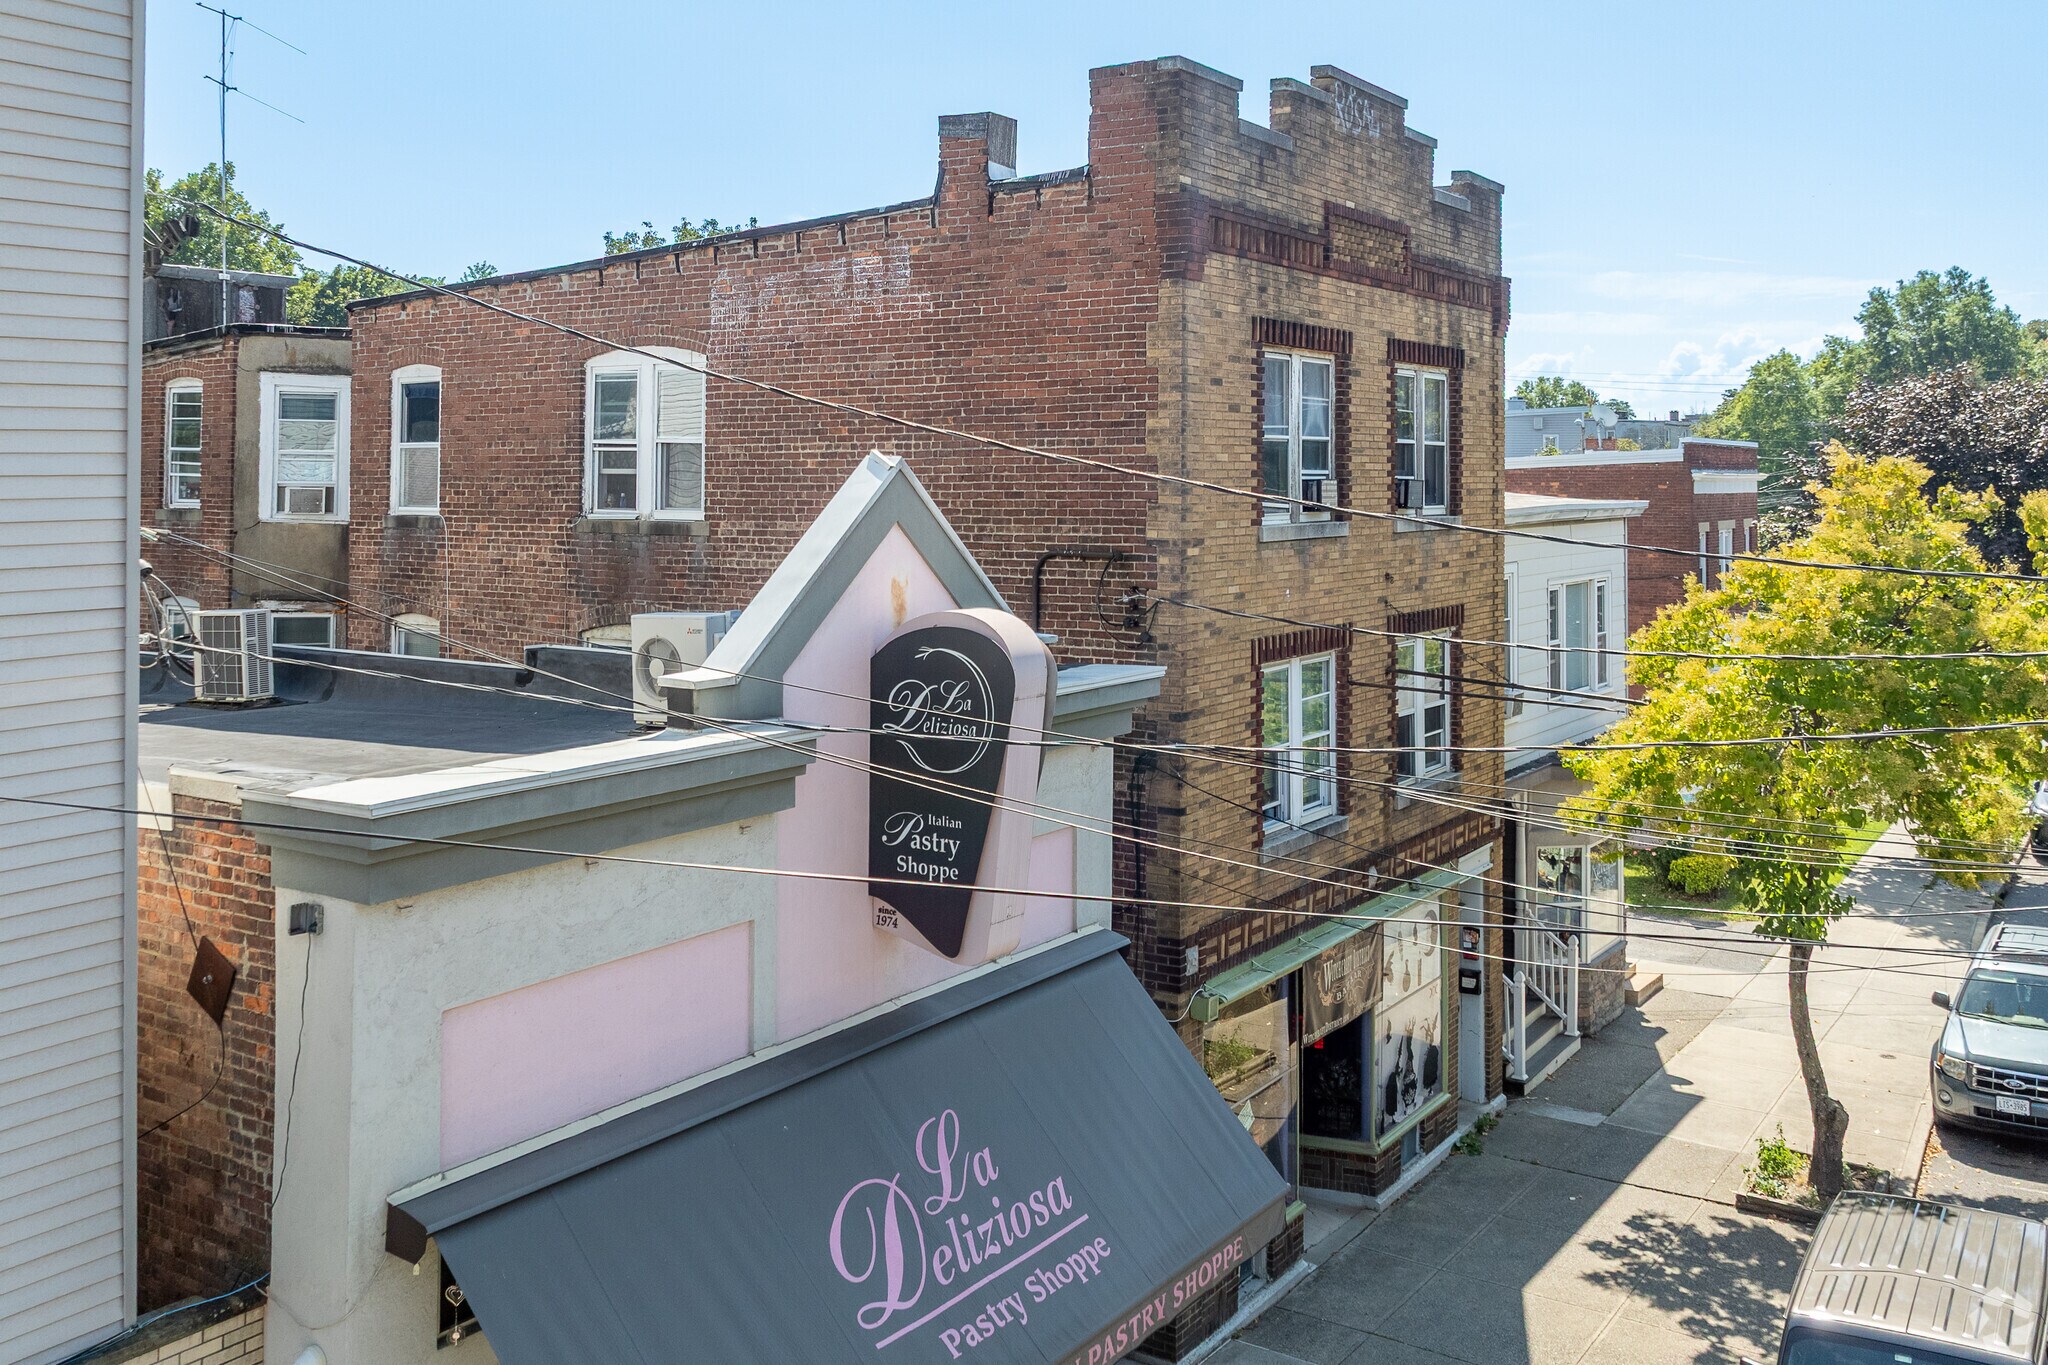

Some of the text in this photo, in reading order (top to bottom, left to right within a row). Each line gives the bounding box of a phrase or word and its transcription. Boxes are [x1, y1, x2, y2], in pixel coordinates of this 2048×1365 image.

[882, 679, 976, 737] Deliziosa
[932, 680, 970, 713] La
[881, 811, 960, 861] Pastry
[928, 814, 961, 829] Italian
[896, 855, 958, 882] Shoppe
[876, 915, 898, 928] 1974
[878, 906, 896, 916] since
[915, 1108, 998, 1215] La
[829, 1172, 1072, 1329] Deliziosa
[1024, 1236, 1111, 1303] Shoppe
[938, 1291, 1028, 1360] Pastry
[1088, 1236, 1243, 1365] PASTRY SHOPPE
